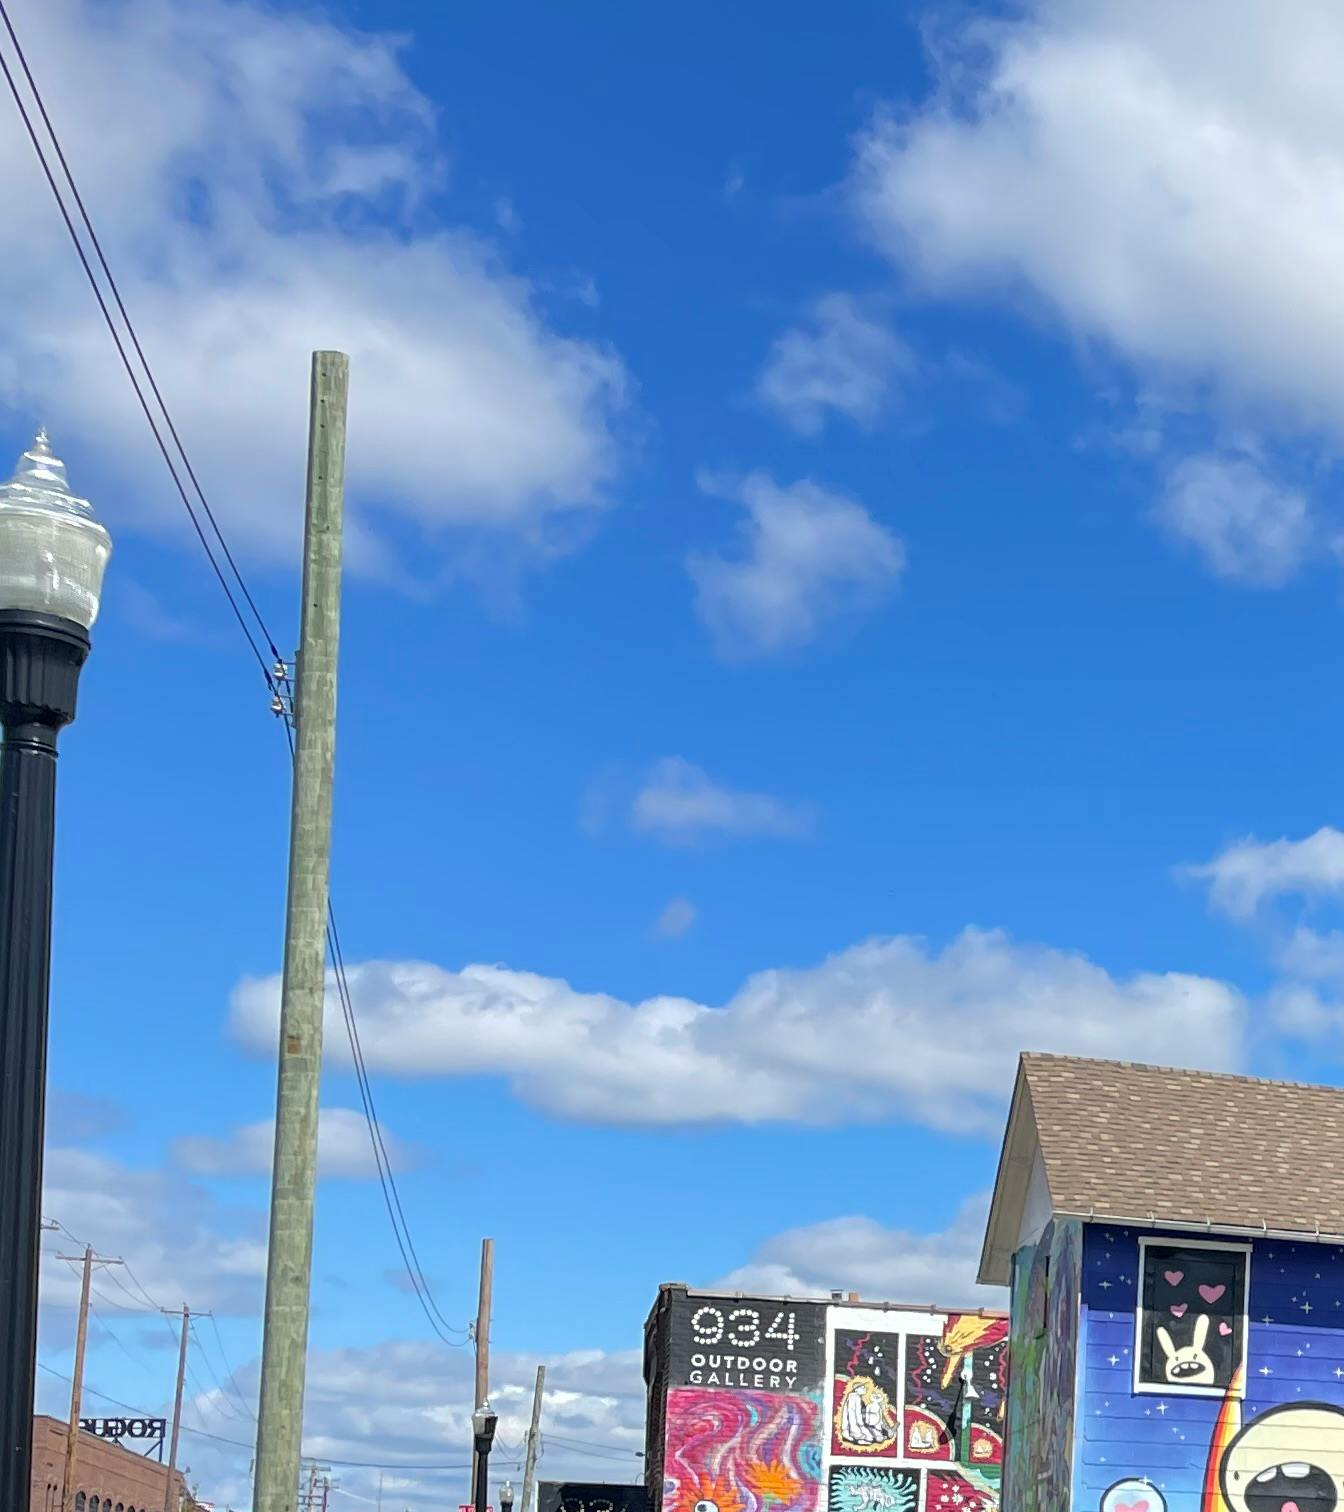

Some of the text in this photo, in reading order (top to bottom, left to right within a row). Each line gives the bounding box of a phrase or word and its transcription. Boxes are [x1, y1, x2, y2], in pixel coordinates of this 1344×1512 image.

[690, 1306, 800, 1351] 934
[690, 1353, 798, 1374] OUTDOOR
[689, 1370, 798, 1389] GALLERY
